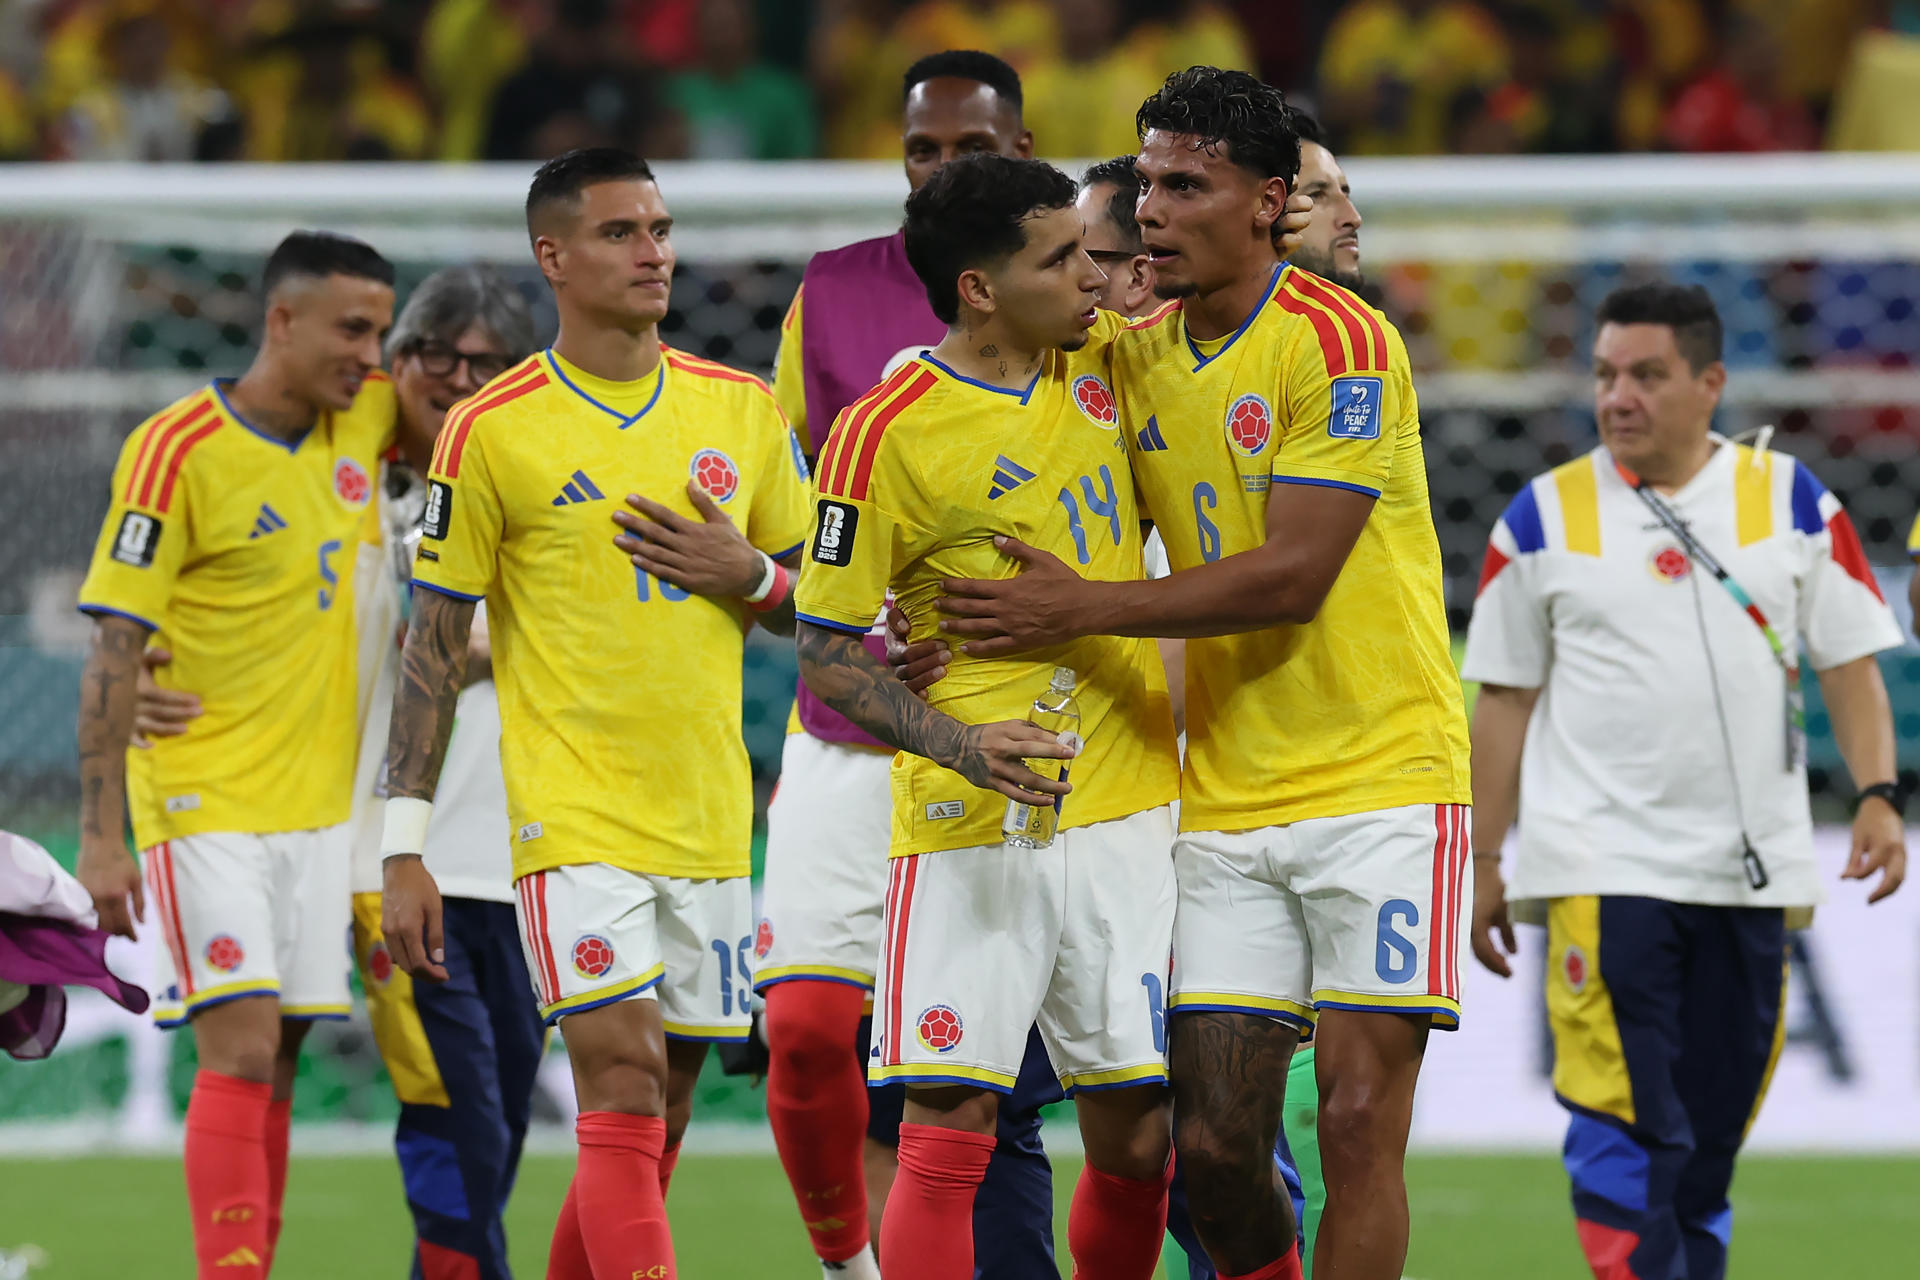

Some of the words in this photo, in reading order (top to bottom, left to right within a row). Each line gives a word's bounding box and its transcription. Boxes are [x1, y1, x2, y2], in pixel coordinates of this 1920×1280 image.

[1344, 415, 1368, 426] PEACE
[1058, 464, 1121, 565] 14
[1193, 481, 1222, 564] 6
[318, 540, 341, 611] 5
[1375, 899, 1419, 984] 6
